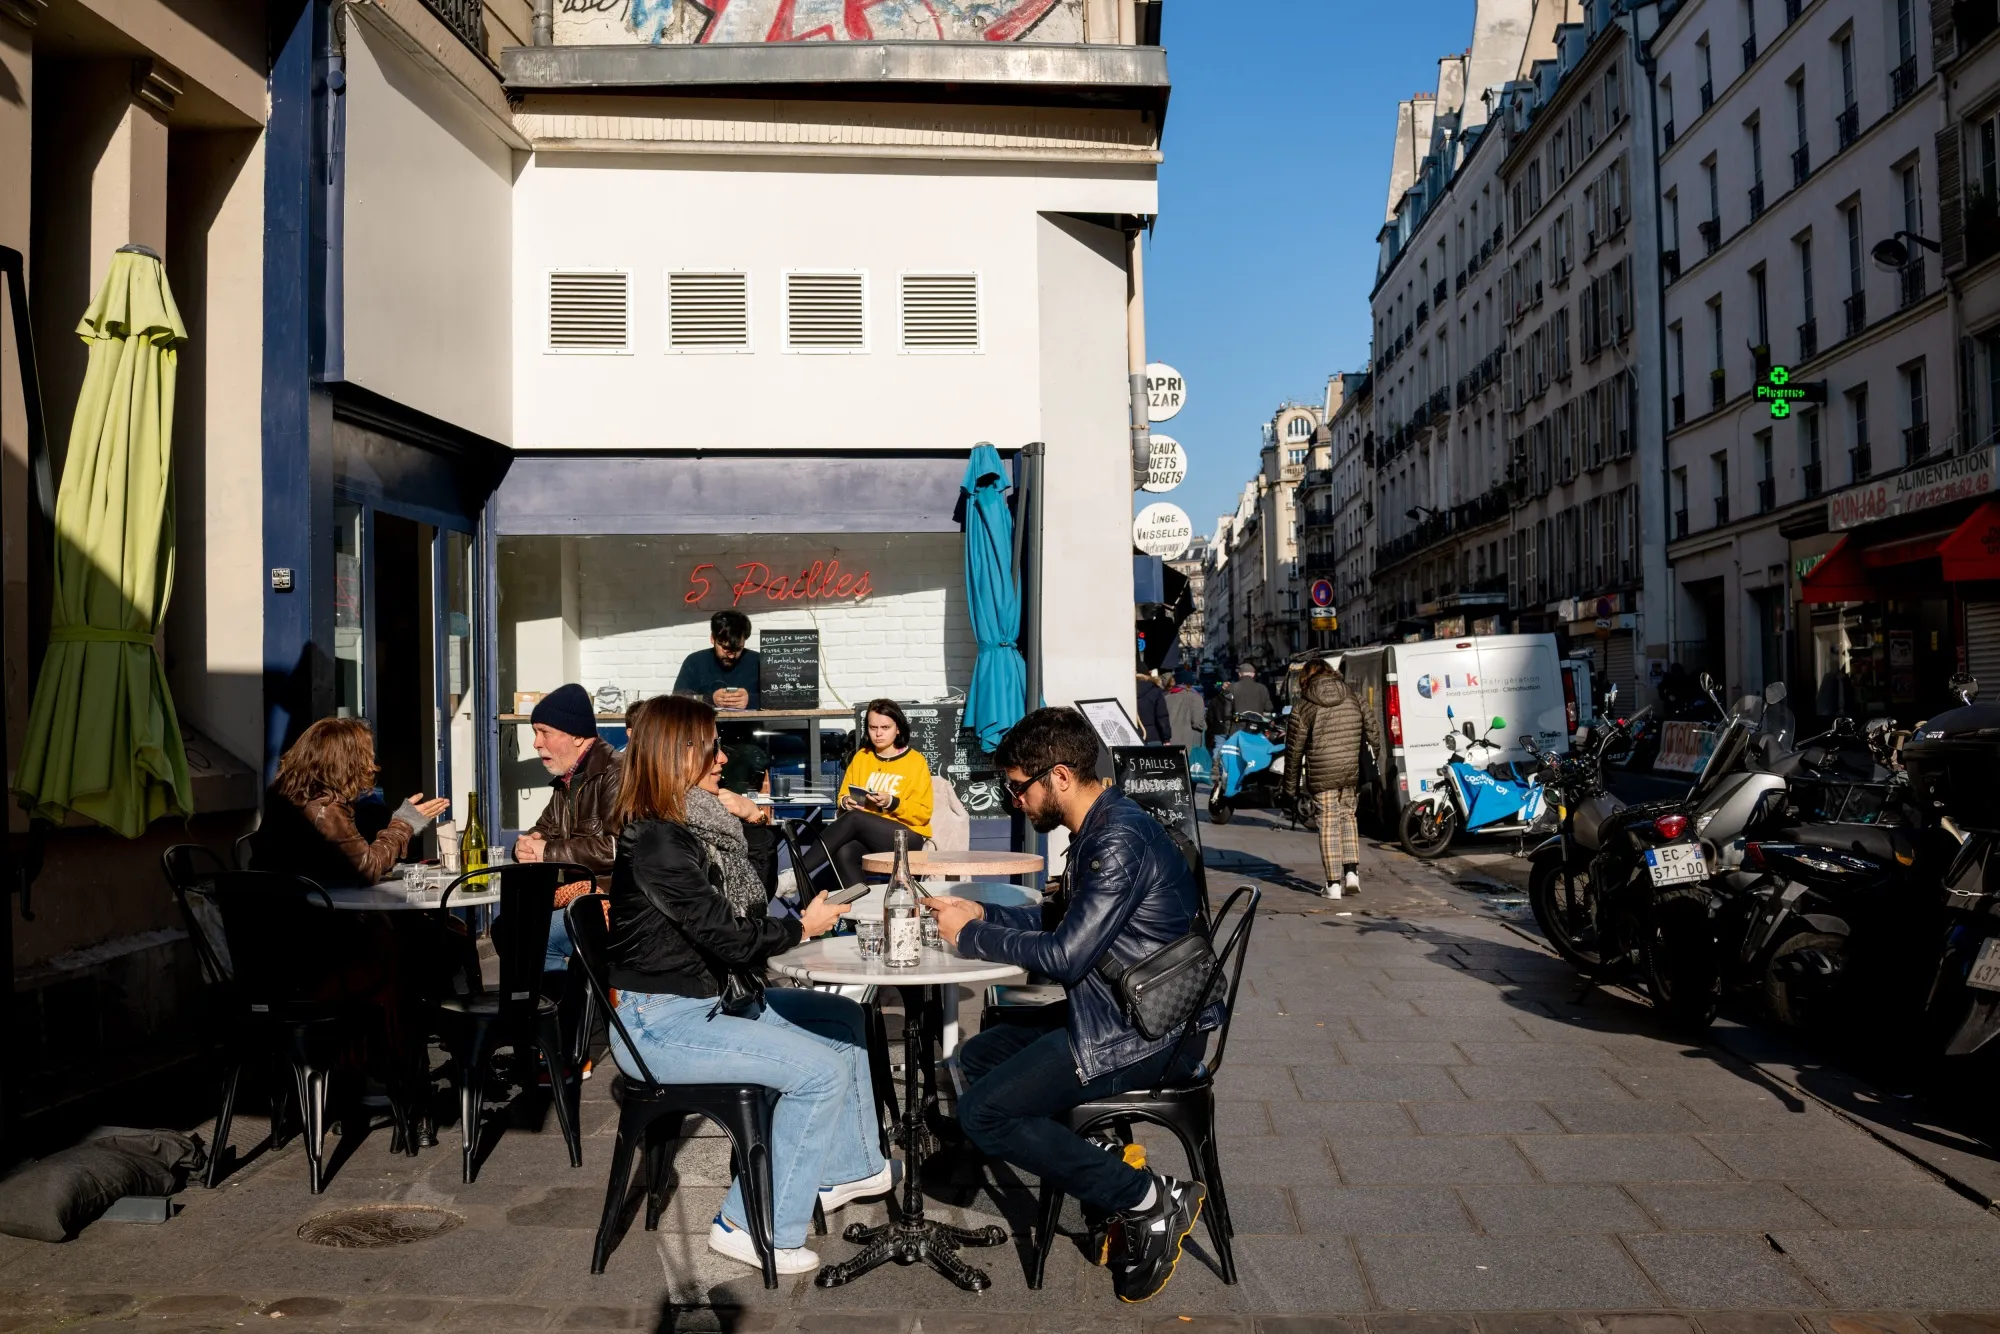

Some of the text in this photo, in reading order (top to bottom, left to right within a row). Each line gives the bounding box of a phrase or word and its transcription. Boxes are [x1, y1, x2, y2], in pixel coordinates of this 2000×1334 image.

[1147, 377, 1182, 391] APRI
[1149, 442, 1177, 455] DEAUX
[1149, 456, 1177, 469] UETS
[1896, 450, 1989, 493] ALIMENTATION
[1832, 486, 1886, 523] PUNJAB
[1137, 527, 1189, 541] VAISSELLES
[685, 560, 872, 607] 5 Pailles
[1502, 684, 1541, 694] Climatisation
[1130, 757, 1176, 772] 5 PAILLES
[866, 771, 906, 797] NIKE
